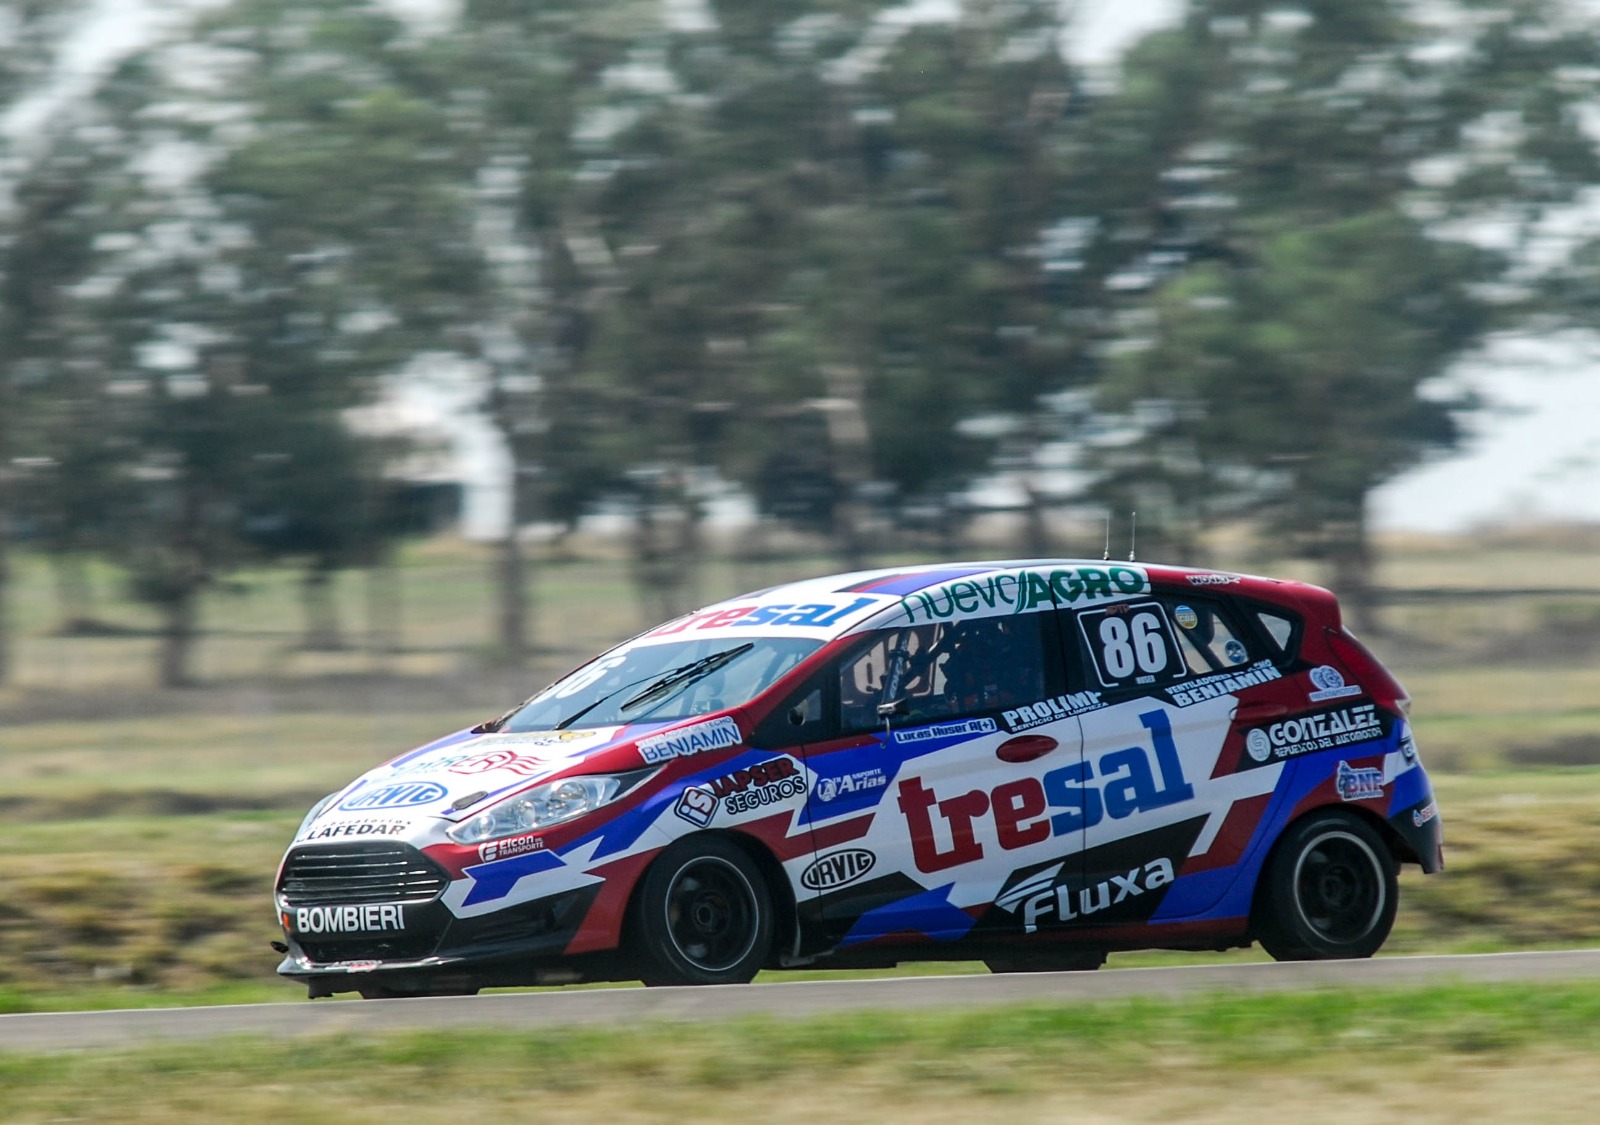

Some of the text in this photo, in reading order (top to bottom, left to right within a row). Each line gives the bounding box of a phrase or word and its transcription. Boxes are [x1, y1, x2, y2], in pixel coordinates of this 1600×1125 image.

[1099, 612, 1167, 678] 86
[1173, 667, 1282, 707] BENJAMIN
[1012, 717, 1053, 732] SERVICIO
[1068, 702, 1109, 715] LIMPIEZA
[1270, 704, 1380, 746] GONZALEZ
[642, 725, 739, 761] BENJAMIN
[896, 730, 932, 741] Lucas
[1275, 741, 1318, 757] REPUESTOS
[1320, 738, 1334, 748] DEL
[1336, 727, 1383, 745] AUTOMOTOR
[725, 776, 807, 815] SEGUROS
[838, 775, 886, 794] Arias
[897, 709, 1195, 874] tresal
[308, 824, 405, 841] LAFEDAR
[499, 842, 544, 856] TRANSPORTE
[806, 852, 869, 885] URVIG
[297, 905, 405, 933] BOMBIERI
